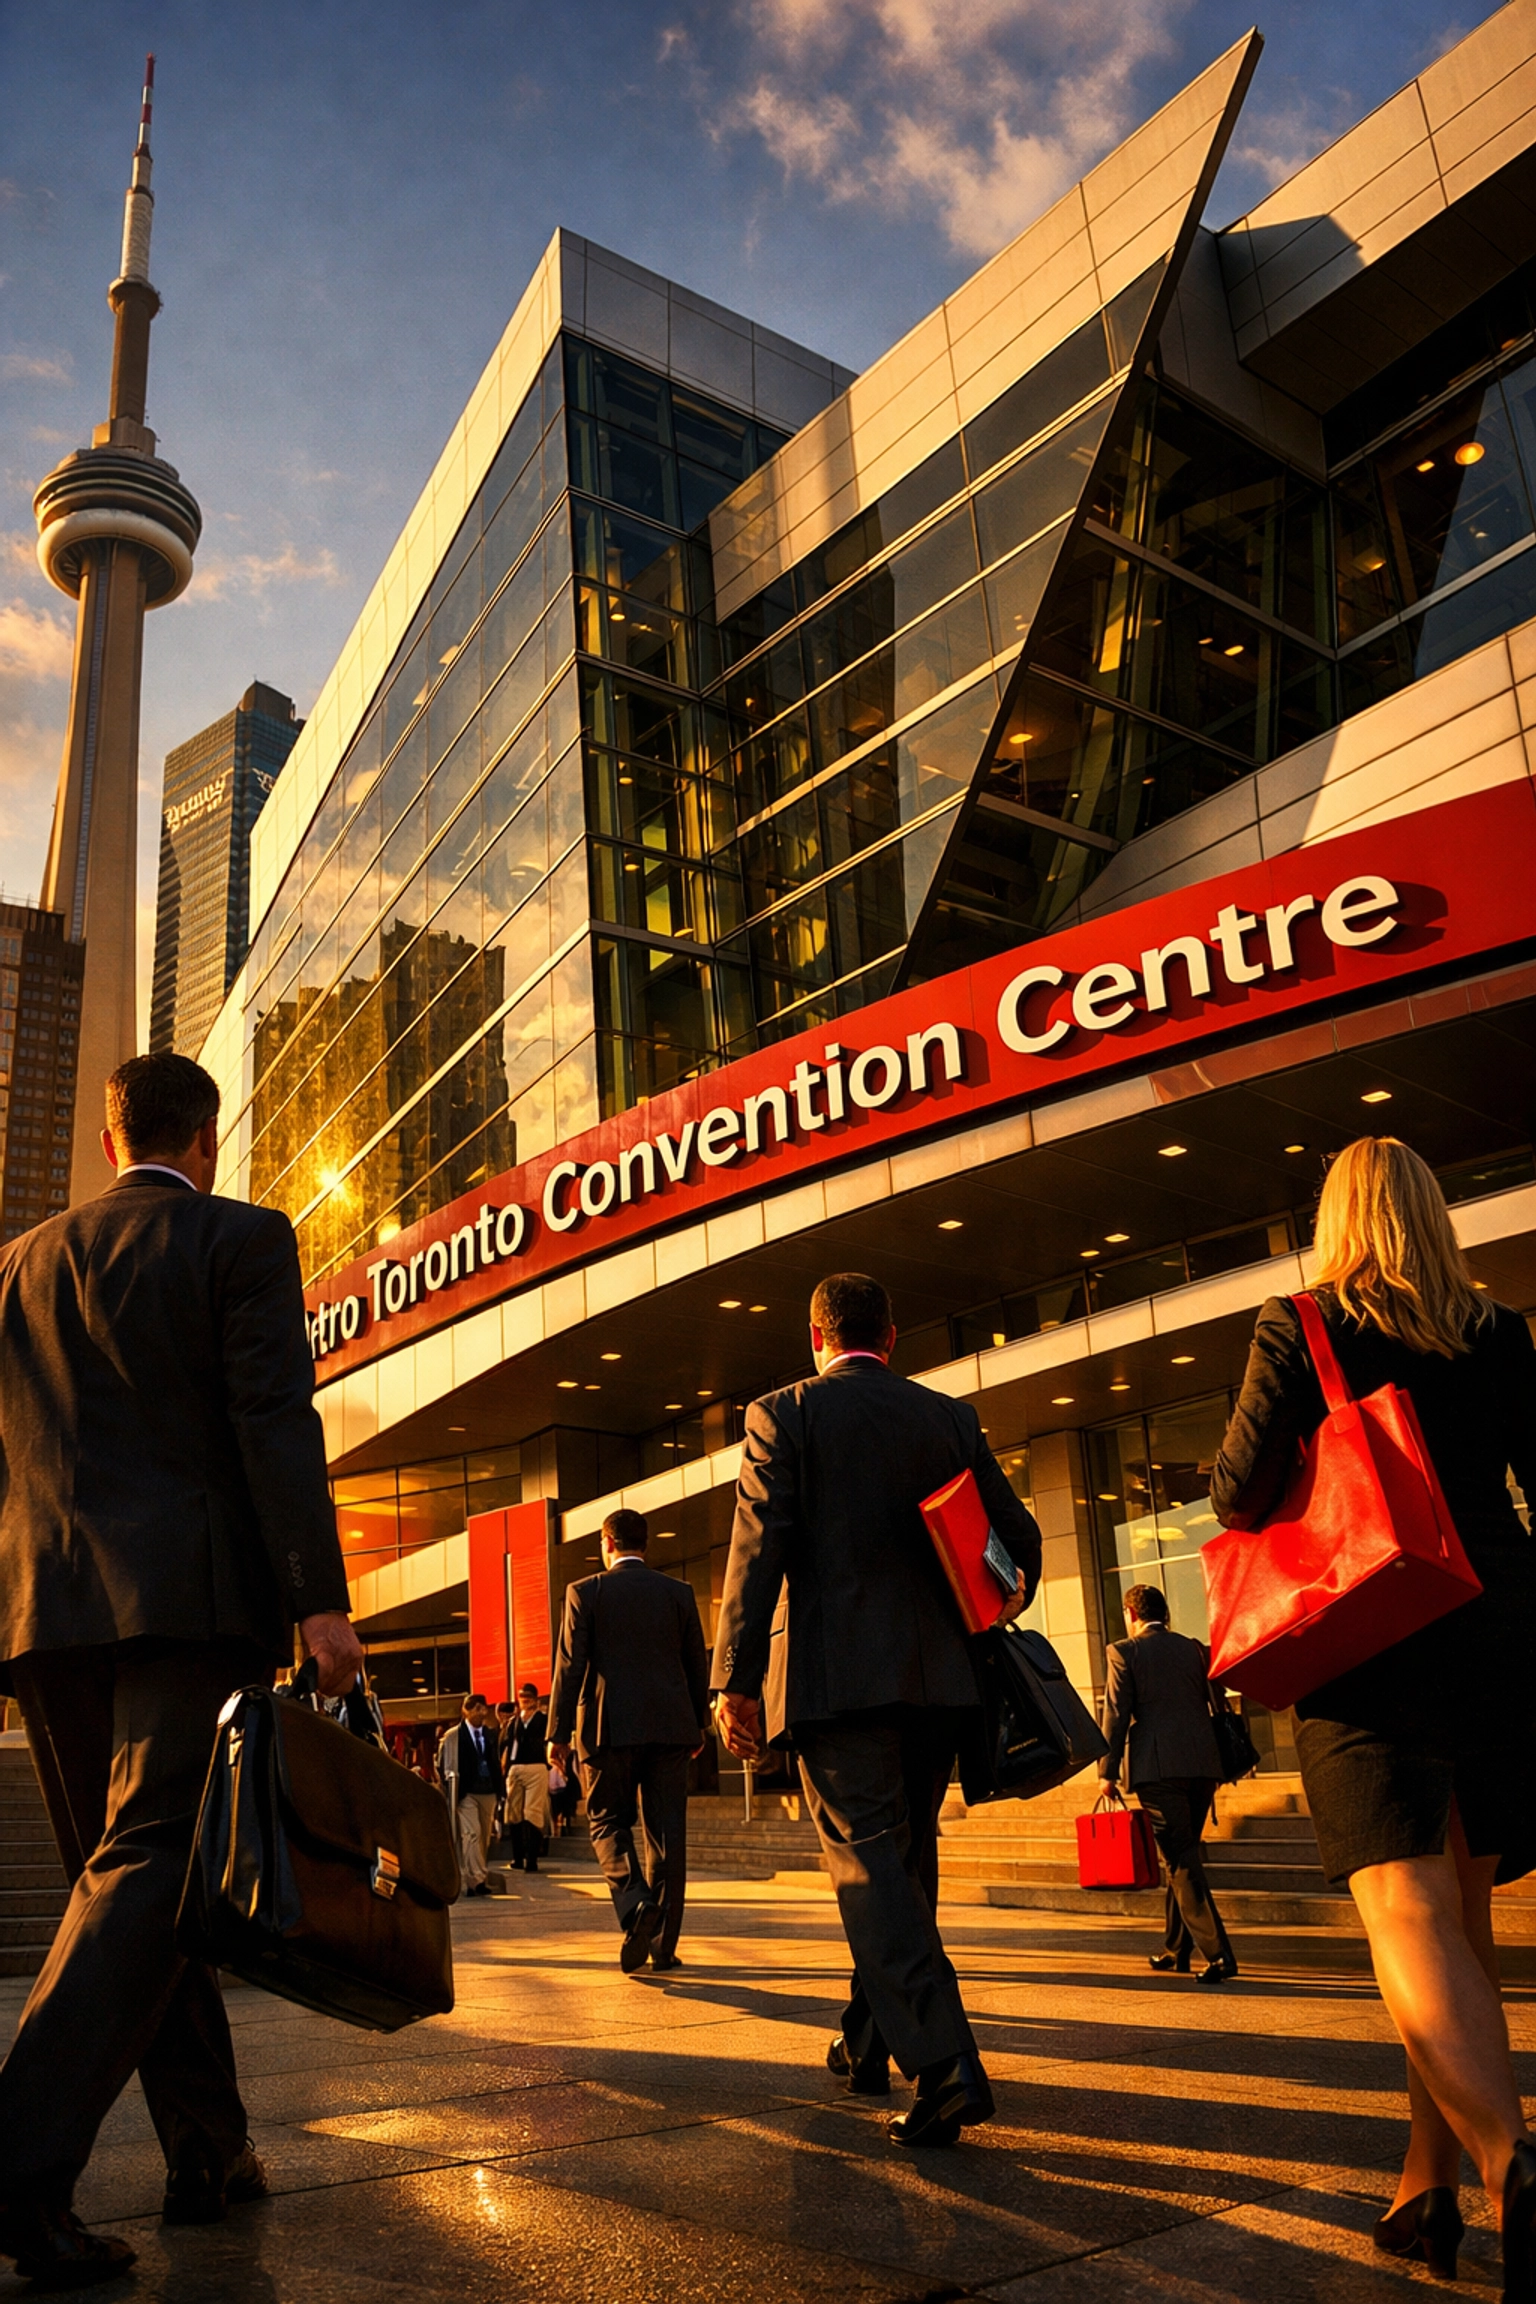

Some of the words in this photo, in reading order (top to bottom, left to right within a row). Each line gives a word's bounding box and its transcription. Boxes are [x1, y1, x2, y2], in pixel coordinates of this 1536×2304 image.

[367, 1202, 525, 1322] Toronto
[542, 1022, 962, 1232] Convention
[997, 875, 1399, 1054] Centre
